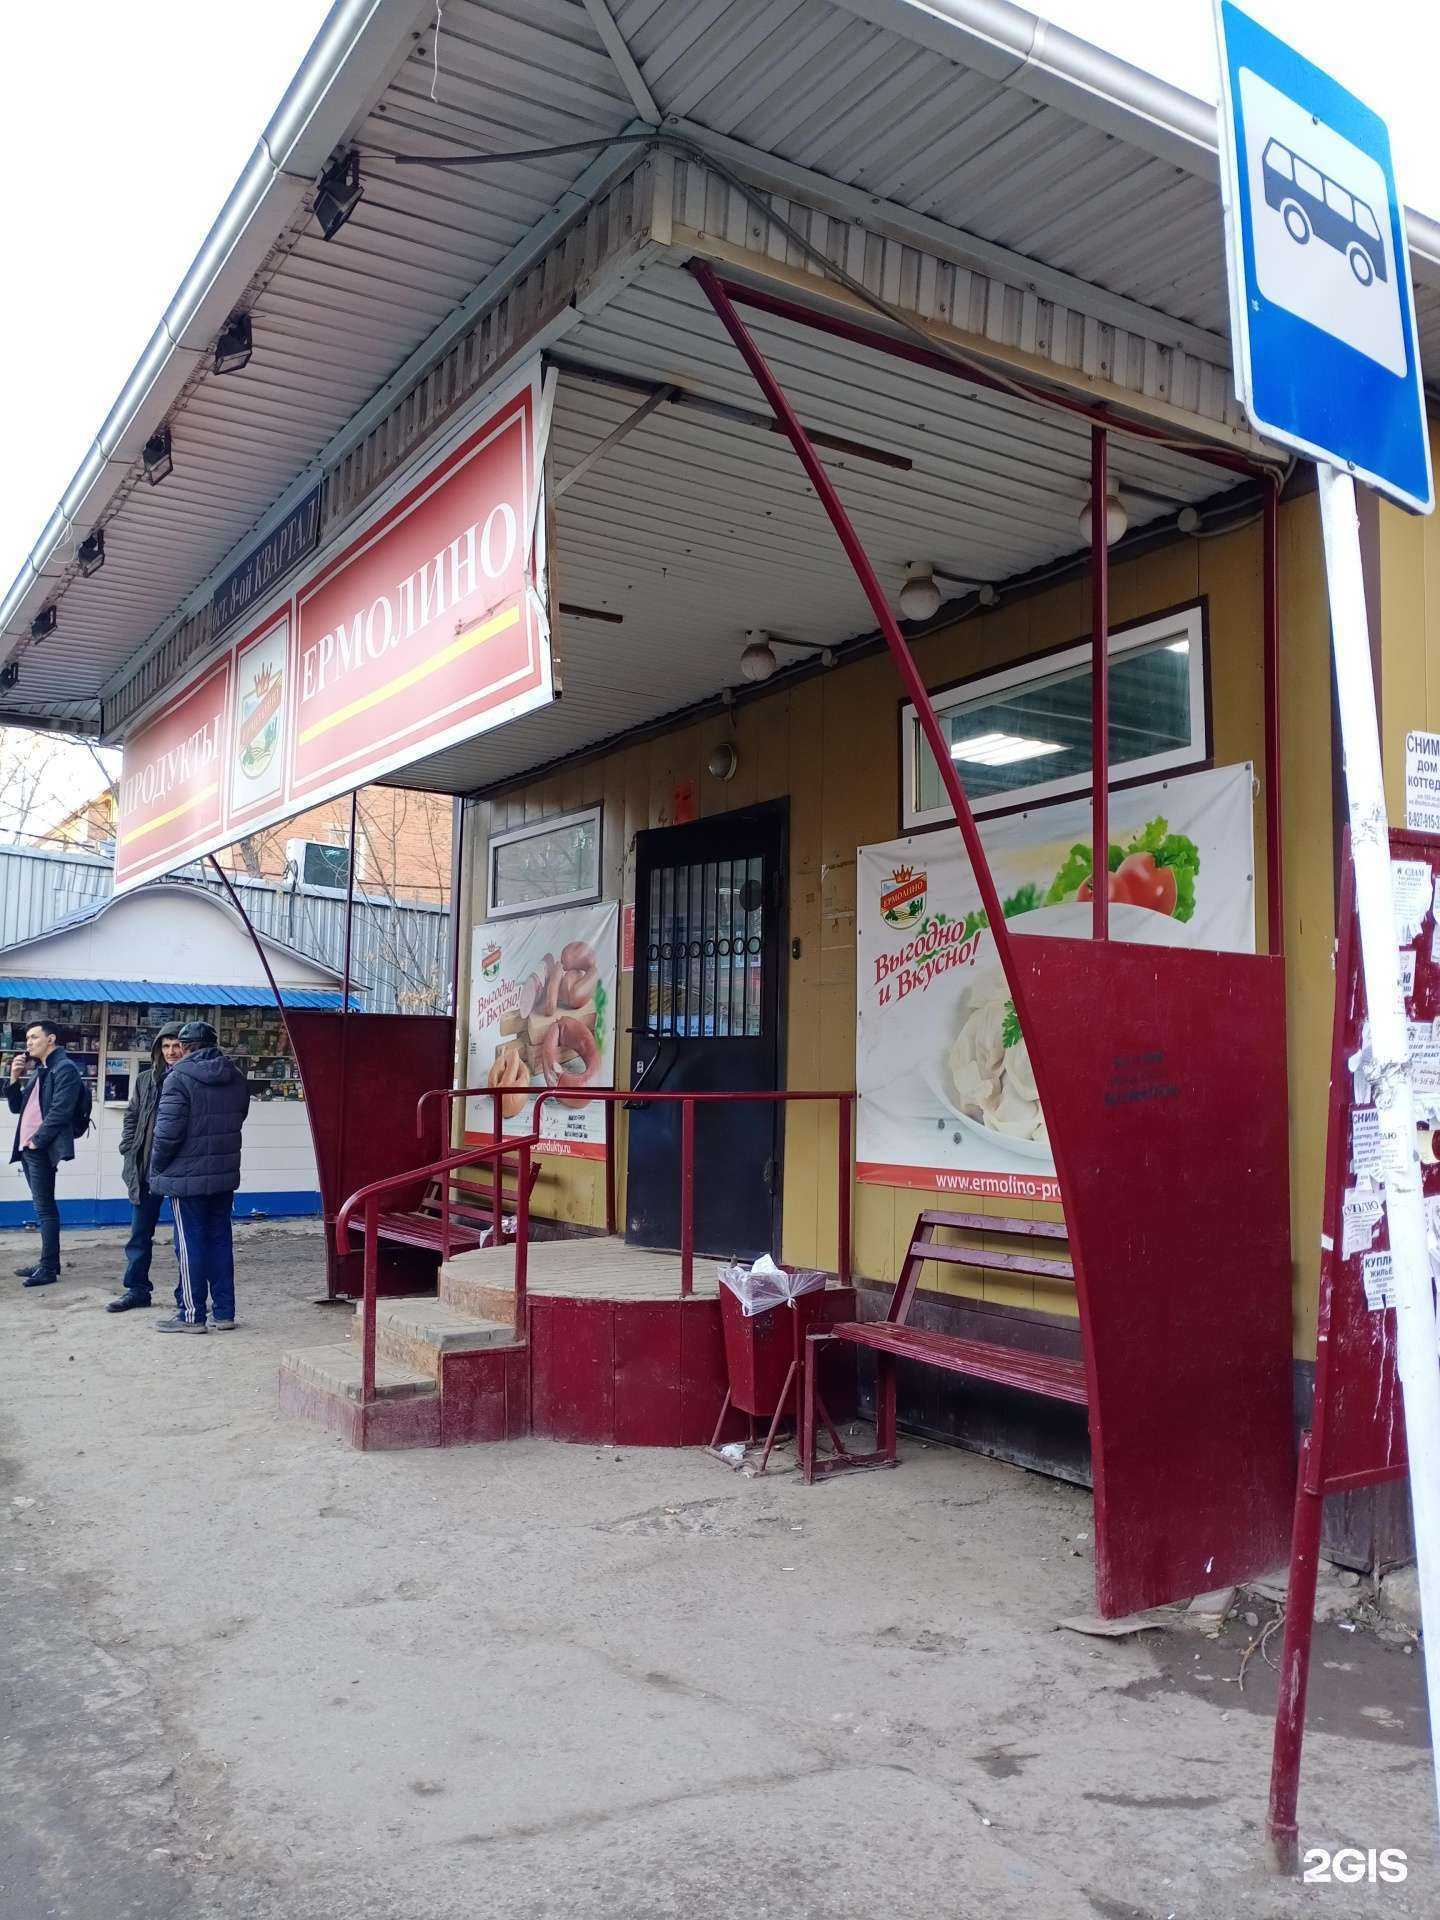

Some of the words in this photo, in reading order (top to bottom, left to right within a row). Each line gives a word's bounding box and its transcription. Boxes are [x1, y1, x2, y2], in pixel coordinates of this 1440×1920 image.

[254, 499, 317, 593] КВАРТАЛ
[301, 503, 517, 704] ЕРМОЛИНО
[124, 712, 224, 818] ПРОДУКТЫ
[874, 921, 965, 986] Выгодно
[879, 984, 891, 1006] и
[896, 931, 982, 1001] Вкусно!
[478, 978, 515, 1017] Выгодно
[486, 986, 521, 1028] Вкусно!
